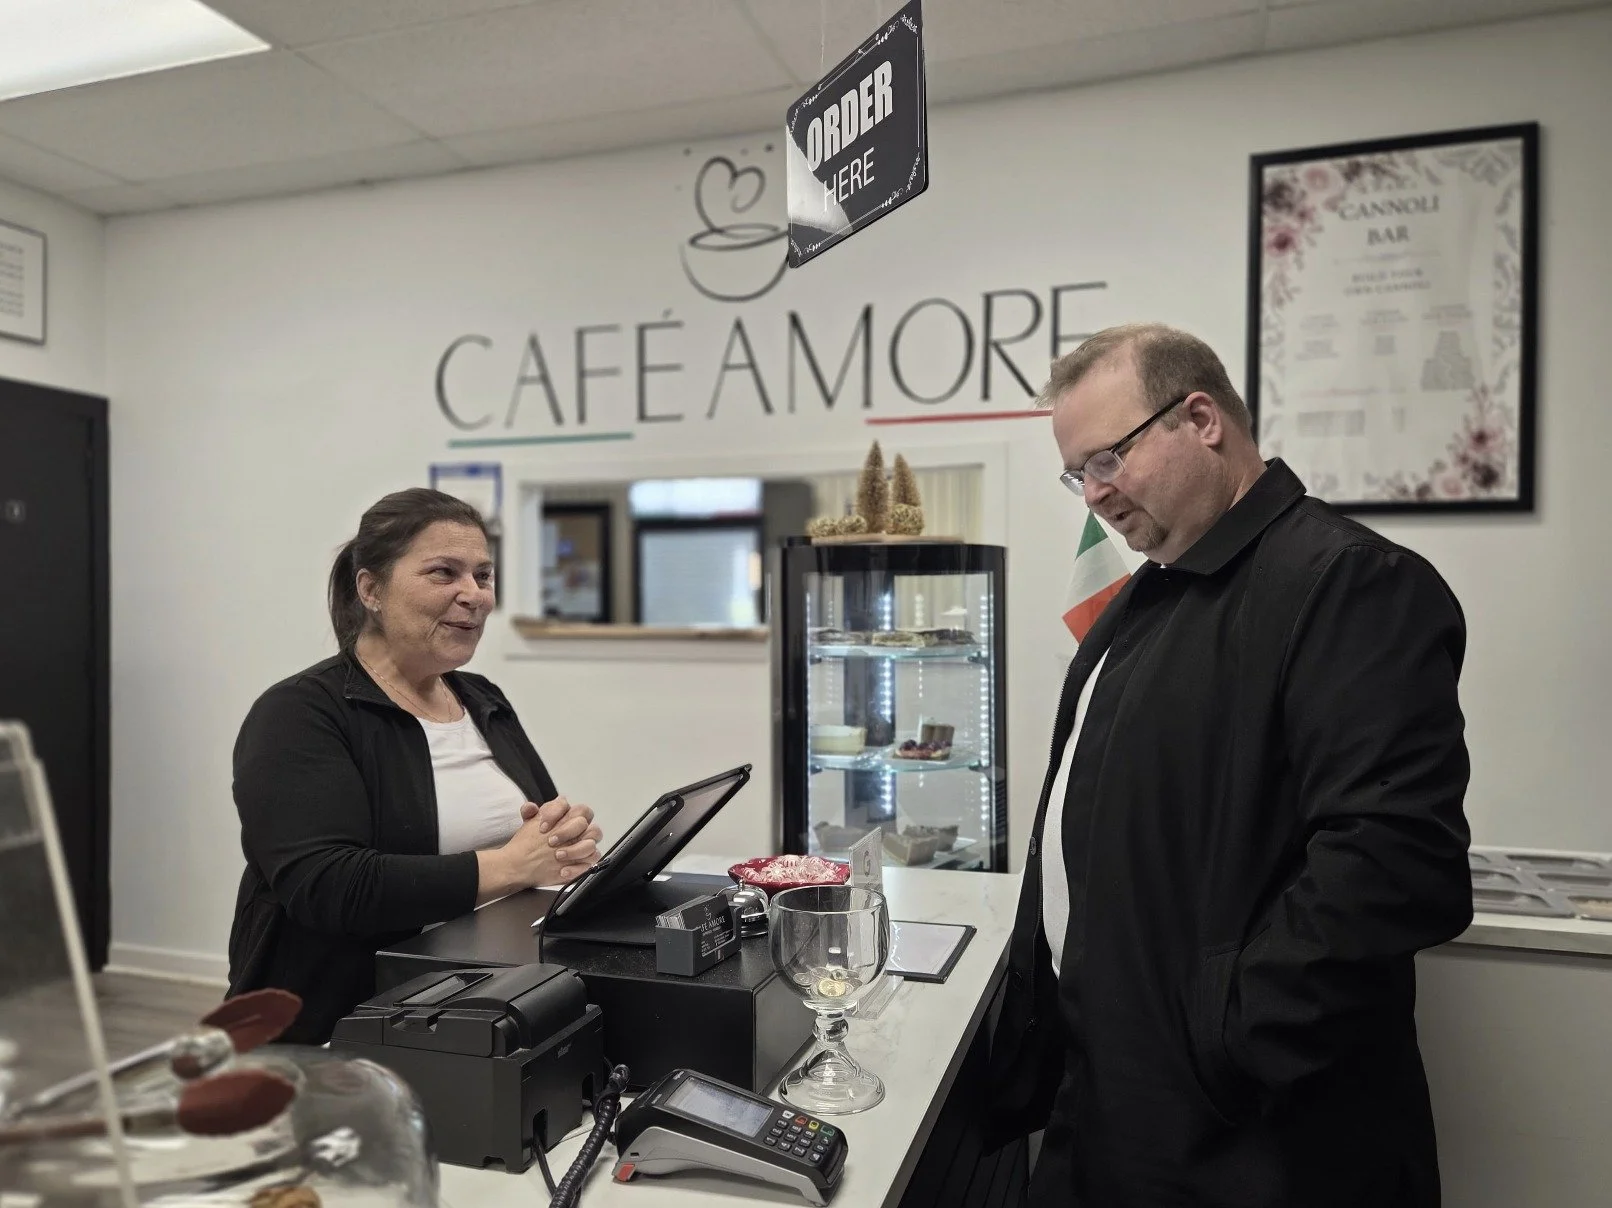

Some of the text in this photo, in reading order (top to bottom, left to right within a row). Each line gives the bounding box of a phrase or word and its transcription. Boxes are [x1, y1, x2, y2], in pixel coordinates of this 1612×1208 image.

[806, 60, 893, 172] ORDER
[823, 146, 875, 213] HERE
[1338, 195, 1440, 221] CANNOLI
[1367, 225, 1410, 246] BAR
[435, 309, 685, 432] CAFÉ
